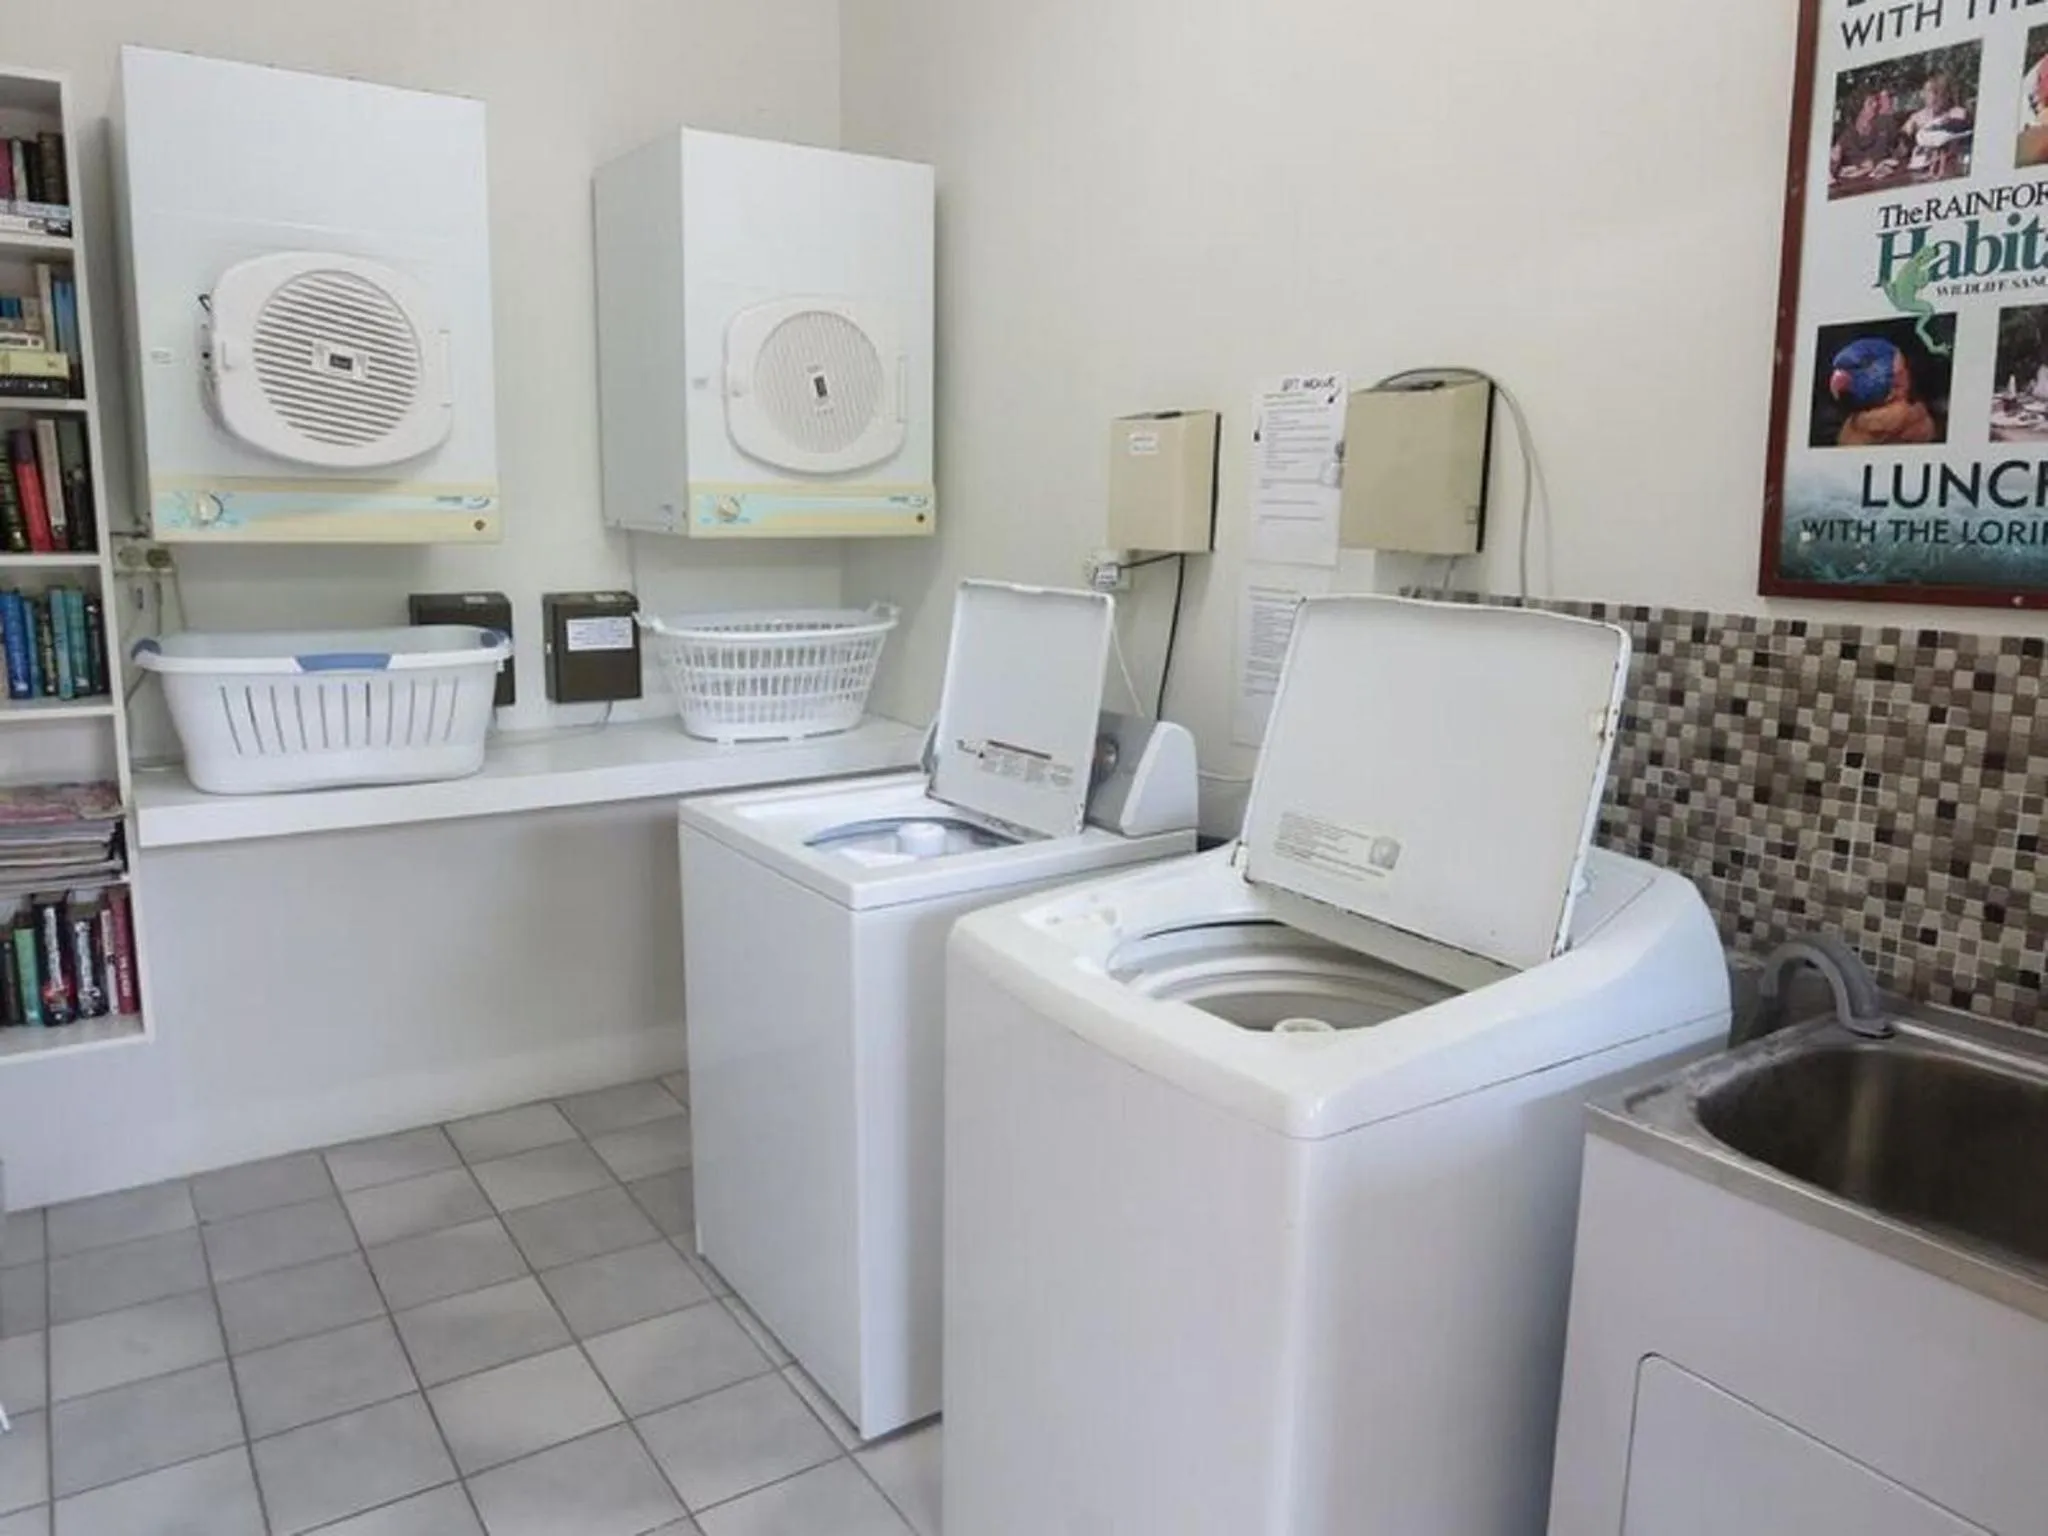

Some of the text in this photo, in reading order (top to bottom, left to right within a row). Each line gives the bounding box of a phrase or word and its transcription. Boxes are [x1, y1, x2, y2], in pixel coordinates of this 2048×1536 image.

[1841, 0, 1943, 49] WITH
[1879, 203, 1923, 228] The
[1872, 212, 2048, 288] Habit
[1860, 460, 2048, 509] LUNC
[1802, 519, 2048, 546] WITH THE LORI
